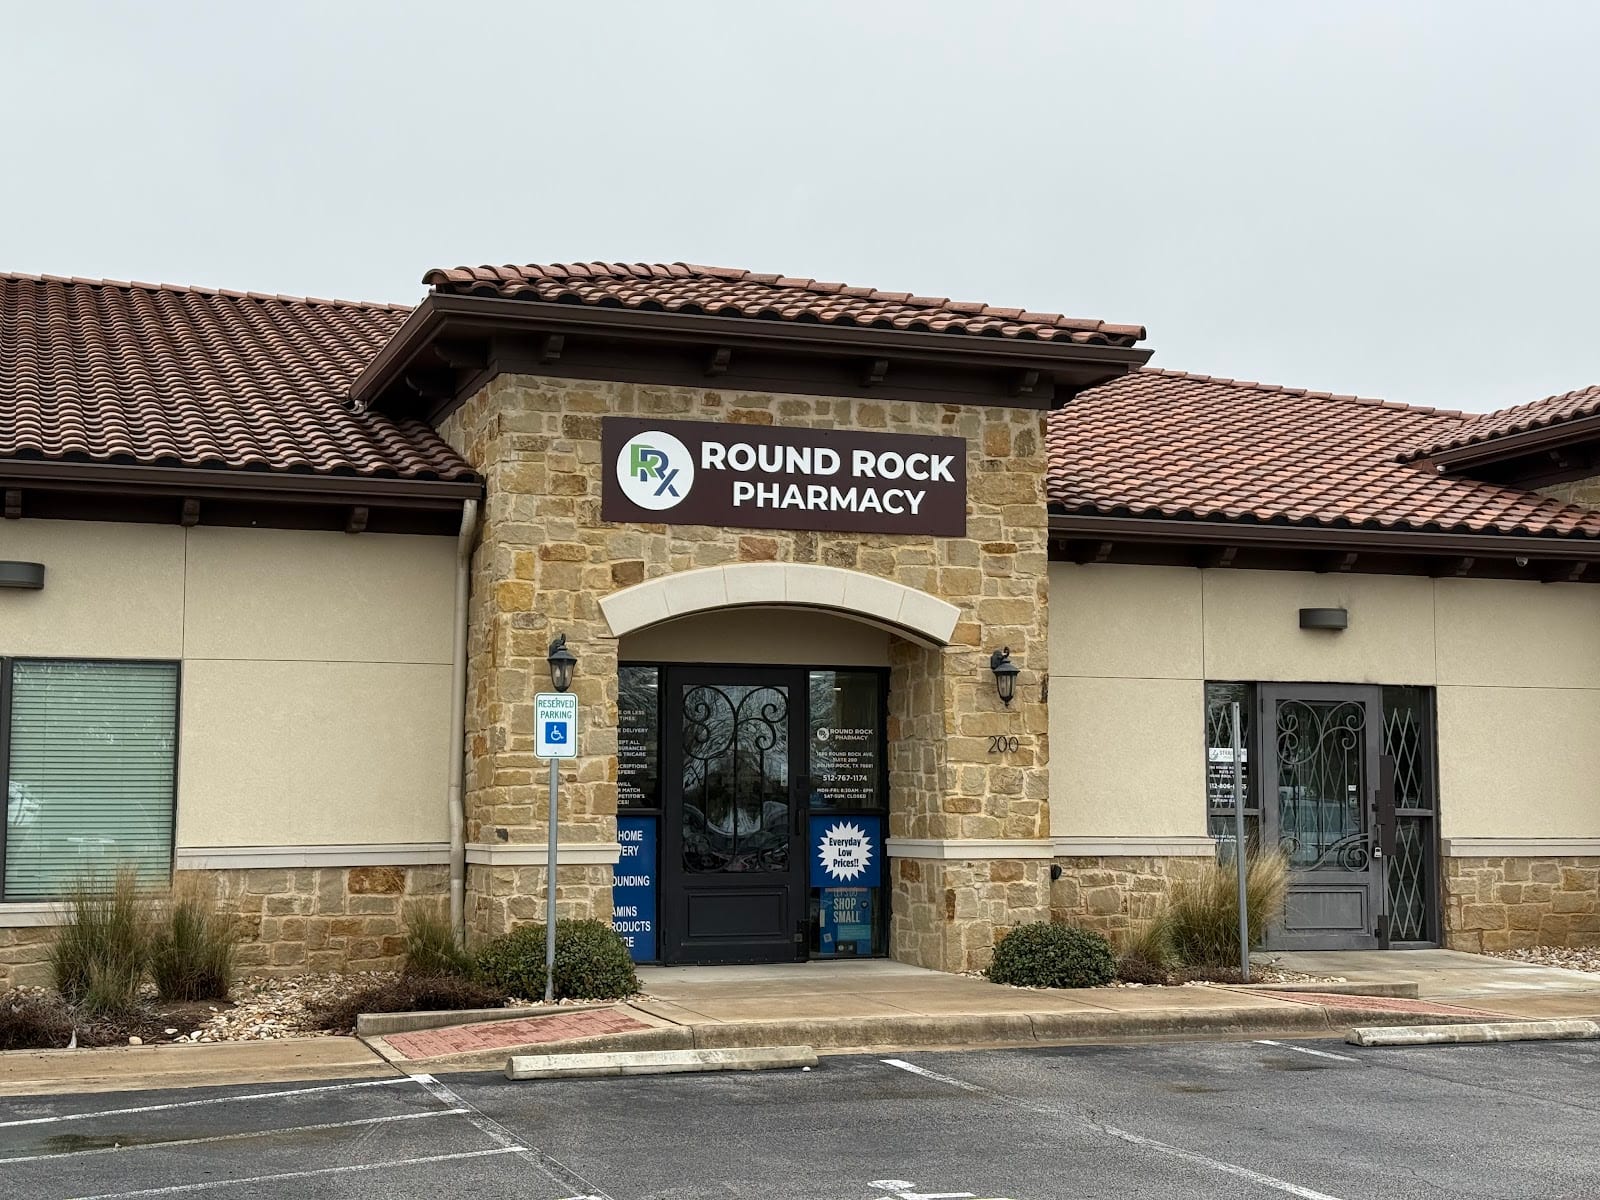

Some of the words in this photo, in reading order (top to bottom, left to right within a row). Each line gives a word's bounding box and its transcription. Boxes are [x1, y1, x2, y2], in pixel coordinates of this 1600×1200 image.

[701, 441, 841, 476] ROUND
[852, 450, 955, 482] ROCK
[732, 481, 926, 515] PHARMACY
[538, 699, 575, 708] RESERVED
[540, 710, 572, 719] PARKING
[988, 735, 1019, 753] 200
[618, 830, 643, 841] HOME
[829, 837, 861, 847] Everyday
[838, 847, 853, 857] Low
[833, 859, 859, 867] Prices!!
[833, 898, 856, 910] SHOP
[833, 911, 860, 923] SMALL
